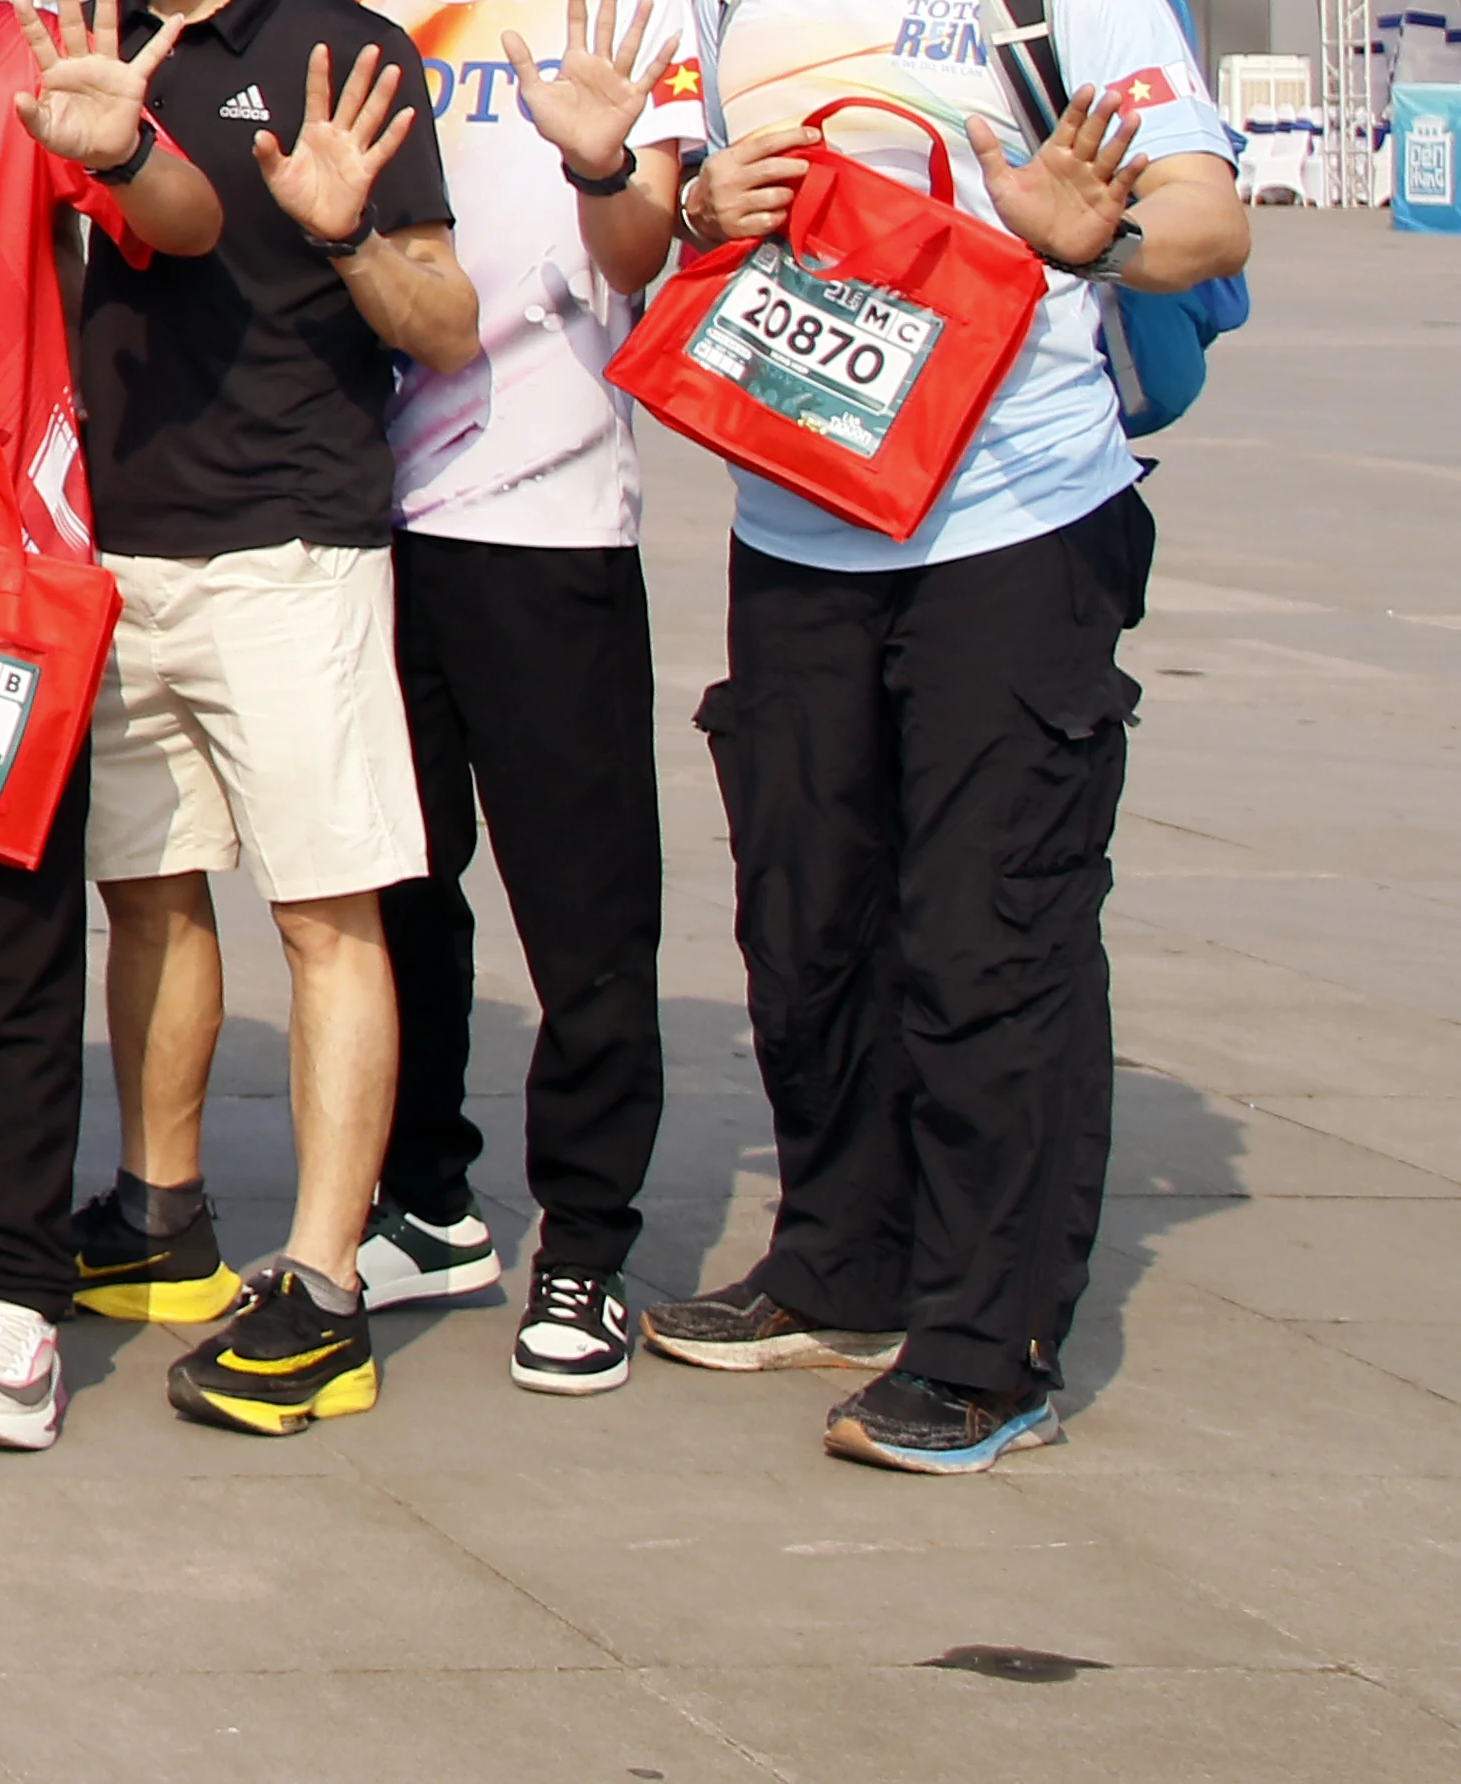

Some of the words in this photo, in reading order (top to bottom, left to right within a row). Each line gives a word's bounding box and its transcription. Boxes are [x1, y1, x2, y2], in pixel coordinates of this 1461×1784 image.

[892, 17, 987, 66] RUN
[742, 287, 885, 385] 20870
[865, 304, 890, 331] M
[898, 323, 919, 343] C
[5, 675, 21, 693] B
